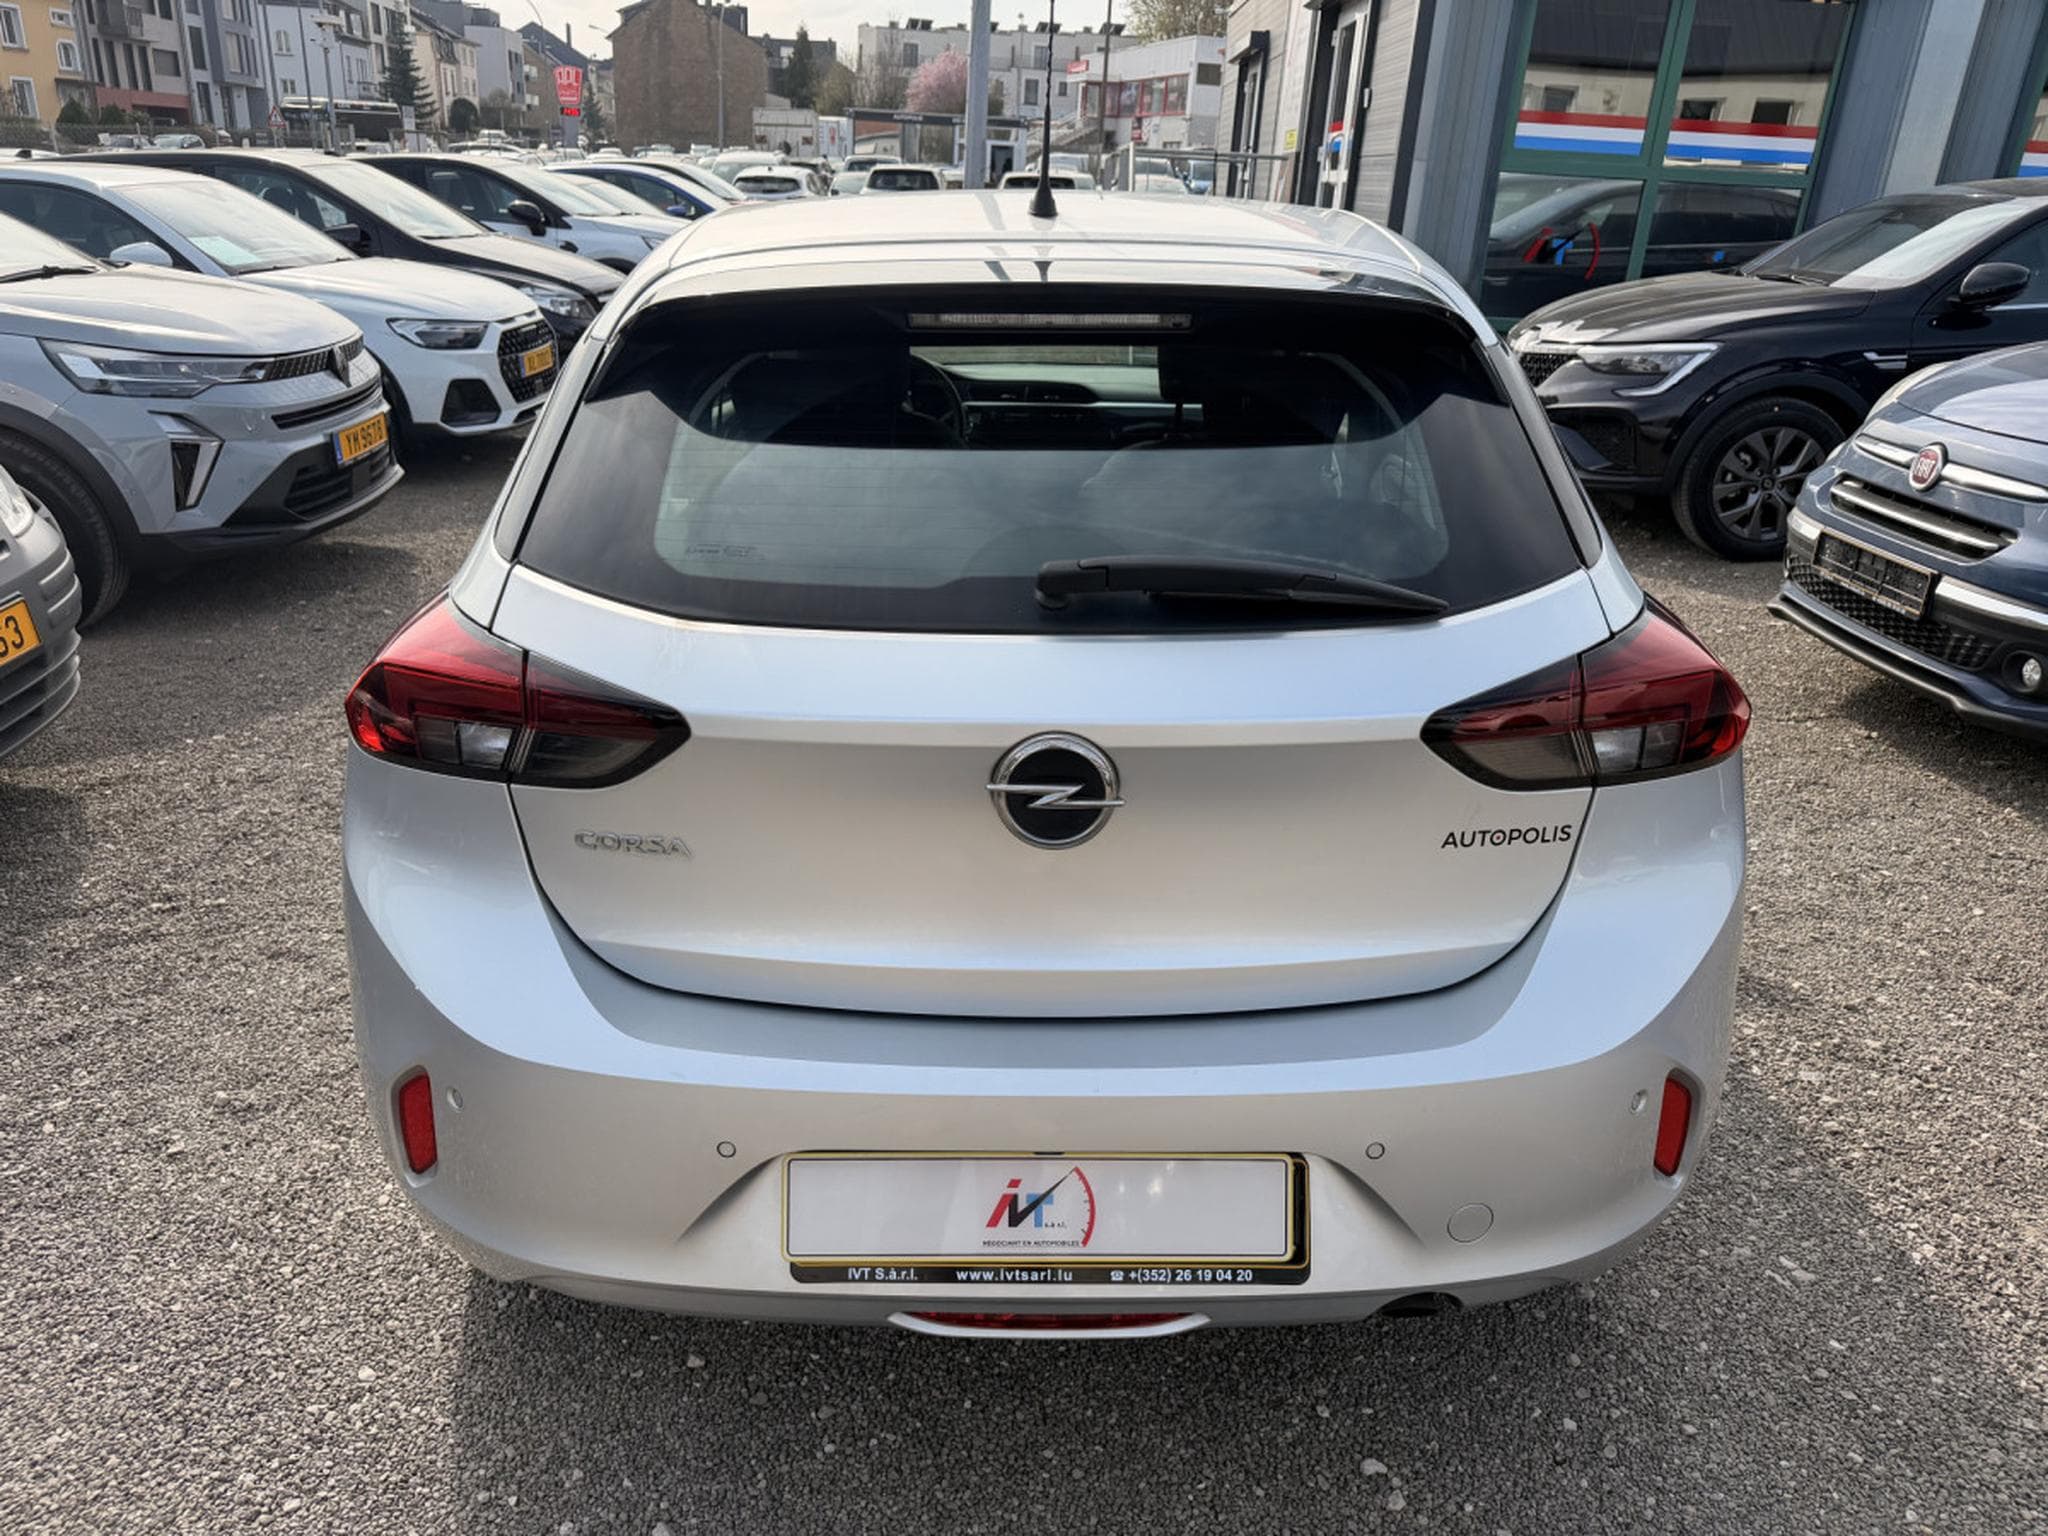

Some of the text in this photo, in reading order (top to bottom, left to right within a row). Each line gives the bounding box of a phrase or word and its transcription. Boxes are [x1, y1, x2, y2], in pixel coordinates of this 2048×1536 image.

[574, 830, 691, 856] CORSA
[1441, 824, 1573, 849] AUTOPOLIS
[848, 1268, 870, 1281] IVT
[956, 1269, 1073, 1281] www.ivtsarl.lu
[1128, 1268, 1172, 1283] +(352)
[1175, 1269, 1192, 1281] 26
[1196, 1269, 1213, 1281] 19
[1216, 1269, 1232, 1281] 04
[1236, 1269, 1253, 1281] 20
